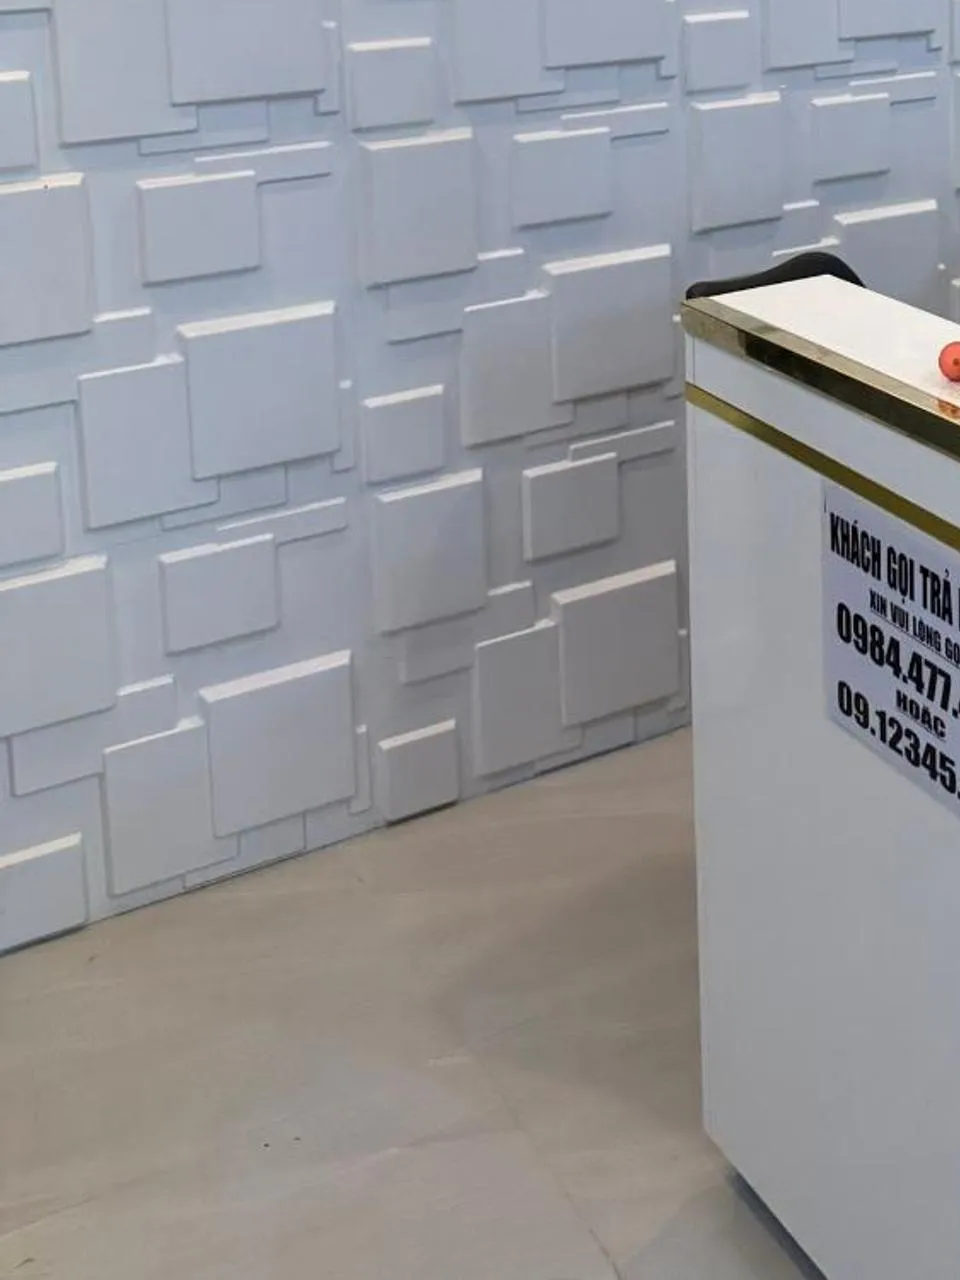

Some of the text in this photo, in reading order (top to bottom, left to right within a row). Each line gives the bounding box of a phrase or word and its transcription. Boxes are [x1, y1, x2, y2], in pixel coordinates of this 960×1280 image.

[830, 512, 882, 581] KHÁCH
[886, 546, 915, 604] GỌI
[919, 565, 954, 625] TRẢ
[869, 588, 888, 617] XIN
[890, 601, 909, 632] VUI
